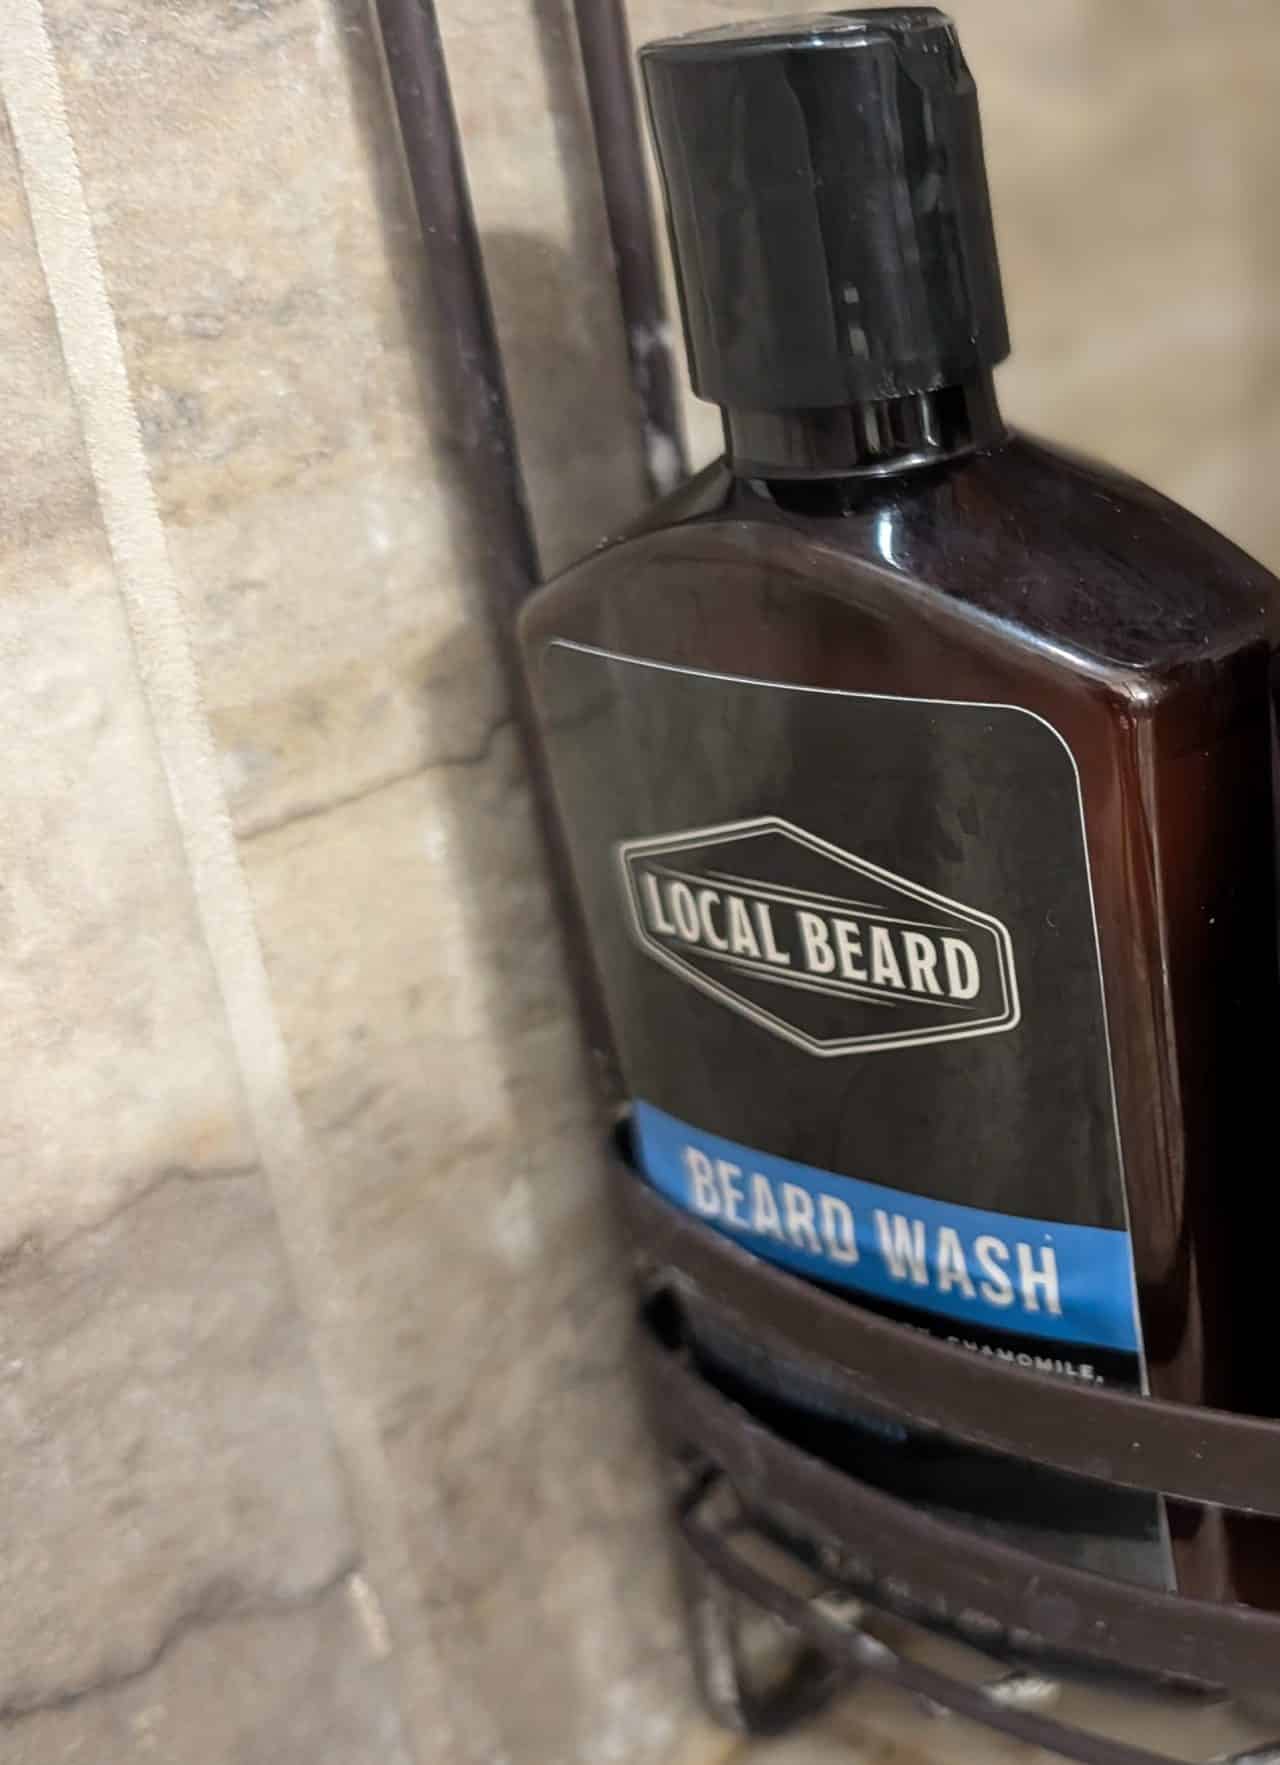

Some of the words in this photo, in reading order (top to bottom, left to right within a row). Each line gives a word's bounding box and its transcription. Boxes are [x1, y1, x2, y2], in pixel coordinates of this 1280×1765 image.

[642, 871, 790, 965] LOCAL
[796, 910, 981, 1000] BEARD
[683, 1145, 860, 1265] BEARD
[873, 1208, 1064, 1318] WASH
